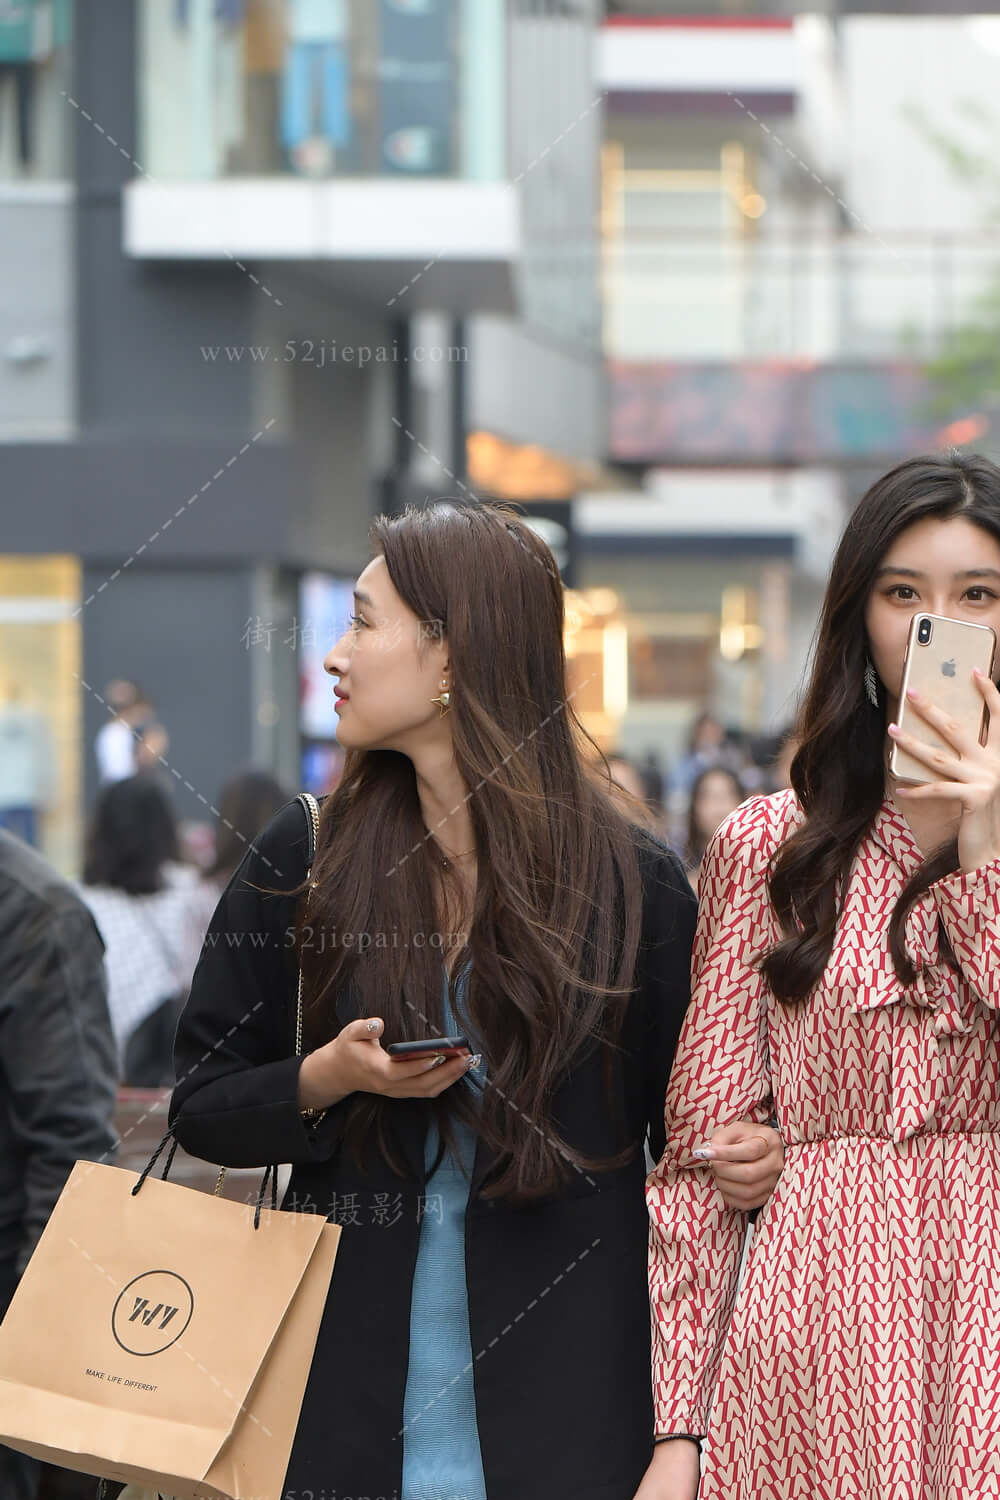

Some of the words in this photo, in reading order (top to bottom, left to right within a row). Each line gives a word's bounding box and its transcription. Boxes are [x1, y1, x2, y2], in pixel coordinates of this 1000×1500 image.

[85, 1368, 105, 1380] MAKE
[107, 1375, 122, 1385] LIFE
[124, 1379, 158, 1393] DIFFERENT
